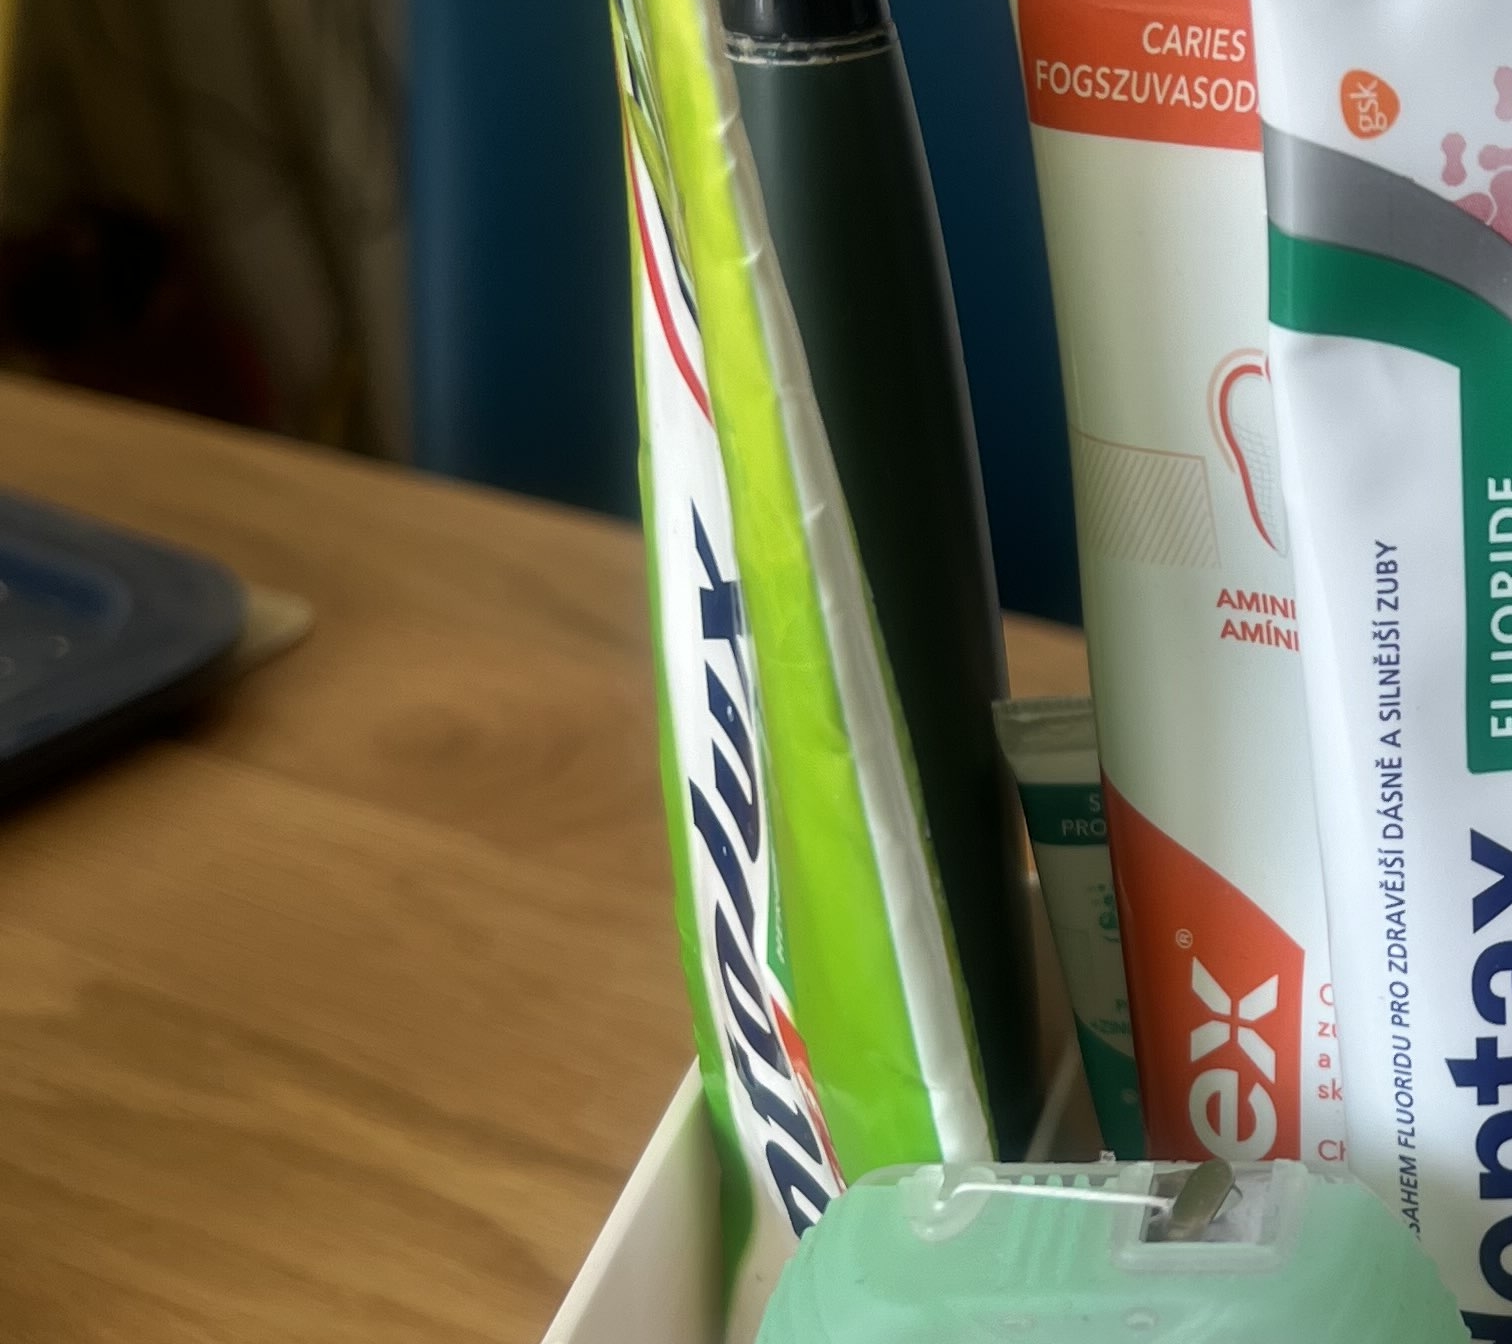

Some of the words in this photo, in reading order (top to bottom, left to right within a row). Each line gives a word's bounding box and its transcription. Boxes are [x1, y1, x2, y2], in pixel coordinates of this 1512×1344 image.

[1141, 21, 1247, 62] CARIES
[1035, 60, 1260, 114] FOGSZUVASOD
[1349, 79, 1388, 133] gsk
[1375, 539, 1399, 612] ZUBY
[1372, 619, 1401, 722] SILNĚJŠÍ
[1380, 728, 1402, 748] A
[1375, 756, 1405, 840] DÁSNĚ
[1378, 847, 1409, 974] ZDRAVĚJŠÍ
[1389, 980, 1411, 1028] PRO
[1392, 1034, 1417, 1150] FLUORIDU
